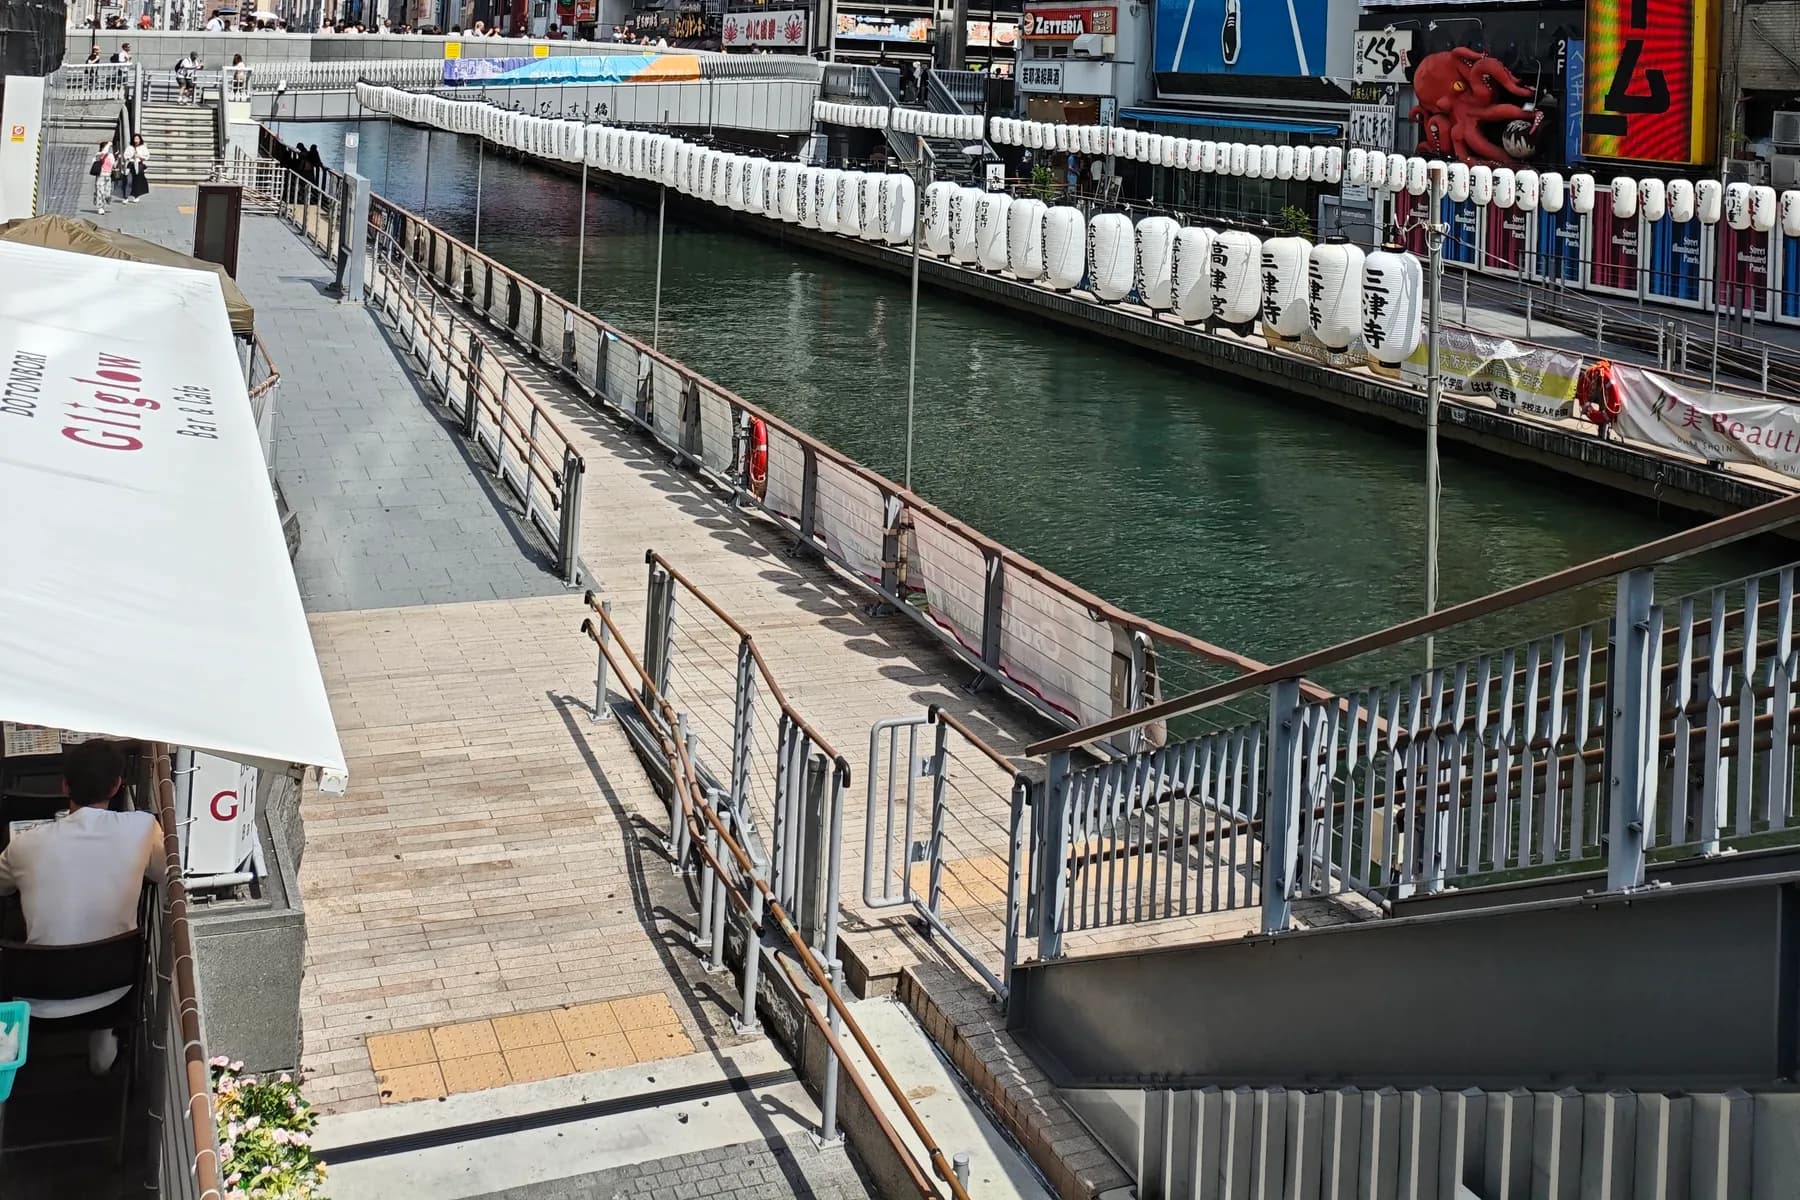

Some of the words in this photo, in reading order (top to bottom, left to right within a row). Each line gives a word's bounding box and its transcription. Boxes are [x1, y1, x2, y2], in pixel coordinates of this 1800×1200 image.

[1036, 16, 1084, 35] ZETTERIA
[1088, 223, 1101, 291] ホテル日航大阪
[1622, 228, 1637, 238] Street
[1683, 236, 1699, 246] Street
[1749, 245, 1766, 255] Street
[1135, 228, 1150, 300] ホテル日航大阪
[1210, 241, 1229, 316] 高津宮
[1261, 253, 1282, 325] 三津寺
[1308, 259, 1325, 331] 三津寺
[1362, 268, 1390, 350] 三津寺
[0, 350, 47, 418] DOTONBORI
[176, 417, 219, 440] Bar
[1682, 405, 1703, 431] 美
[209, 790, 239, 822] G
